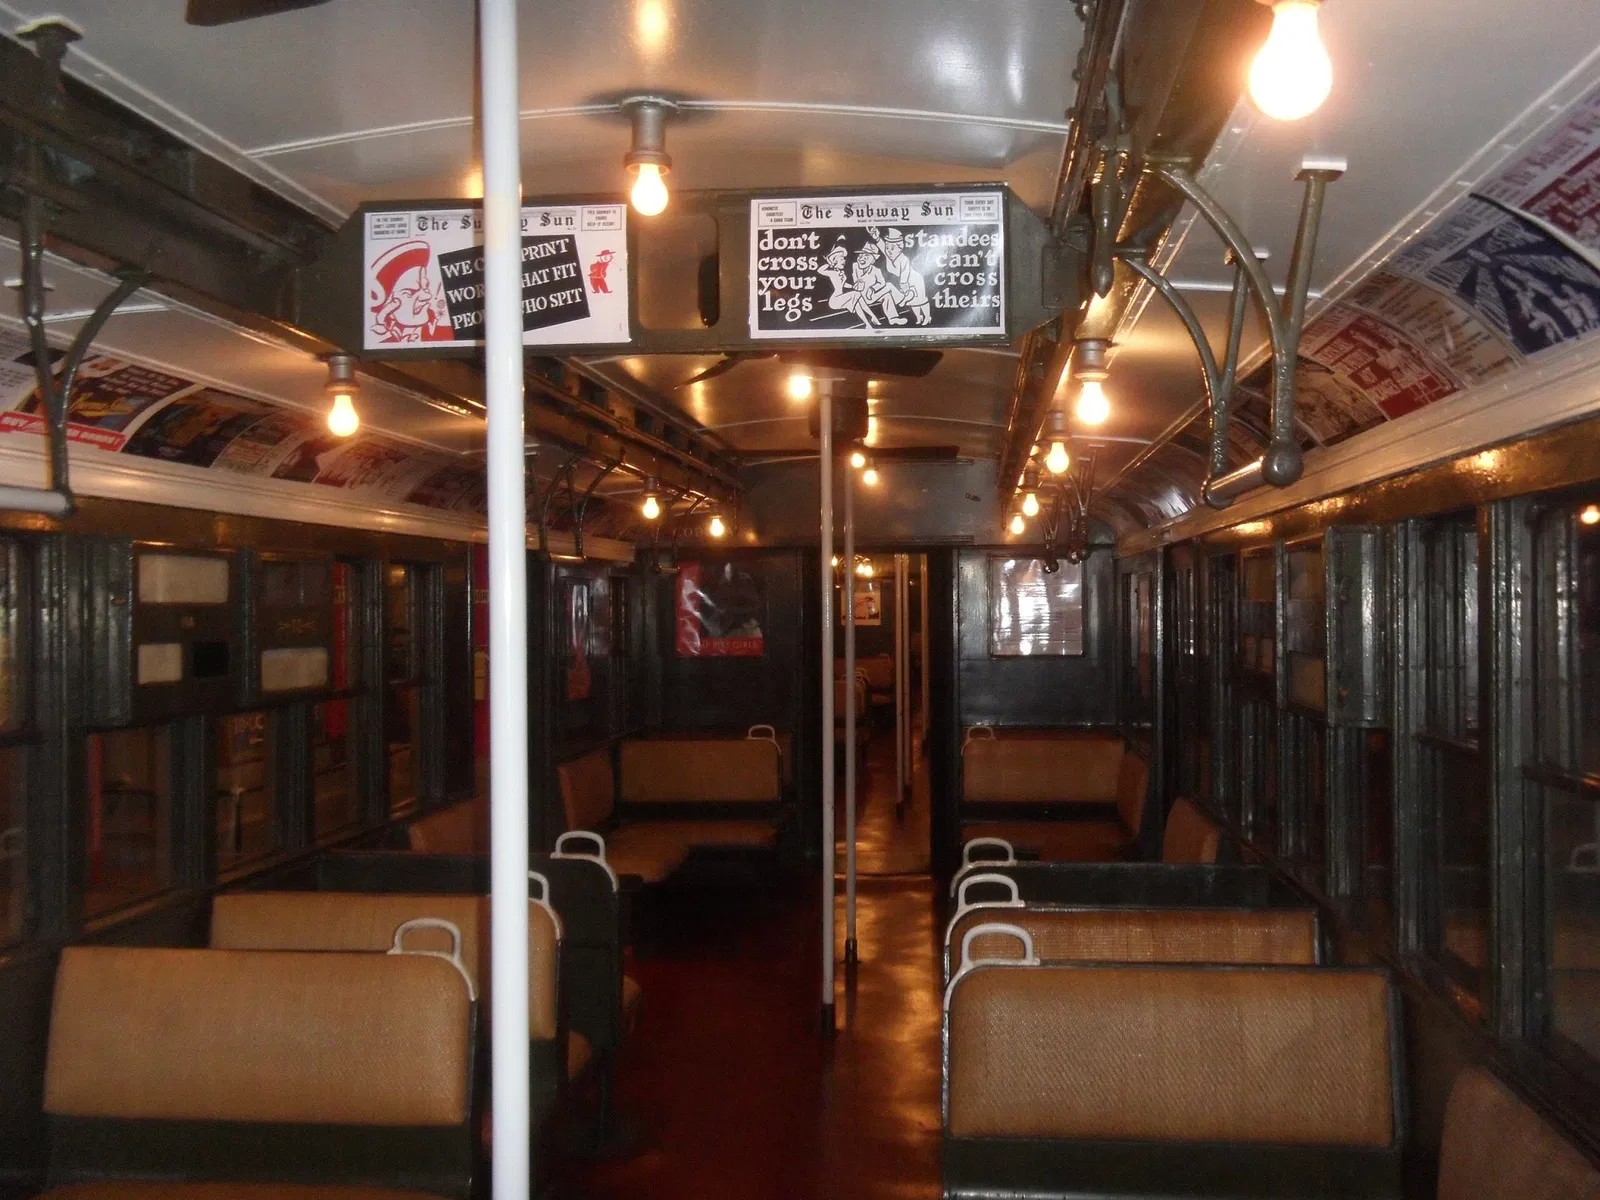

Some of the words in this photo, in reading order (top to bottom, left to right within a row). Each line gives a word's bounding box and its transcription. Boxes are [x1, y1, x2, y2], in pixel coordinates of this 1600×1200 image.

[418, 216, 448, 231] The
[460, 214, 528, 232] Suy
[540, 211, 574, 227] Sun
[801, 204, 833, 220] The
[842, 201, 911, 222] Subway
[920, 200, 955, 217] Sun
[759, 228, 821, 251] don't
[905, 226, 999, 248] standees
[441, 260, 473, 279] WE
[521, 238, 570, 262] PRINT
[758, 255, 819, 272] cross
[935, 250, 997, 268] can't
[521, 268, 550, 289] HAT
[551, 262, 577, 281] FIT
[758, 275, 817, 296] your
[934, 271, 998, 286] cross
[549, 287, 583, 309] SPIT
[762, 292, 813, 322] legs
[932, 289, 1000, 309] theirs
